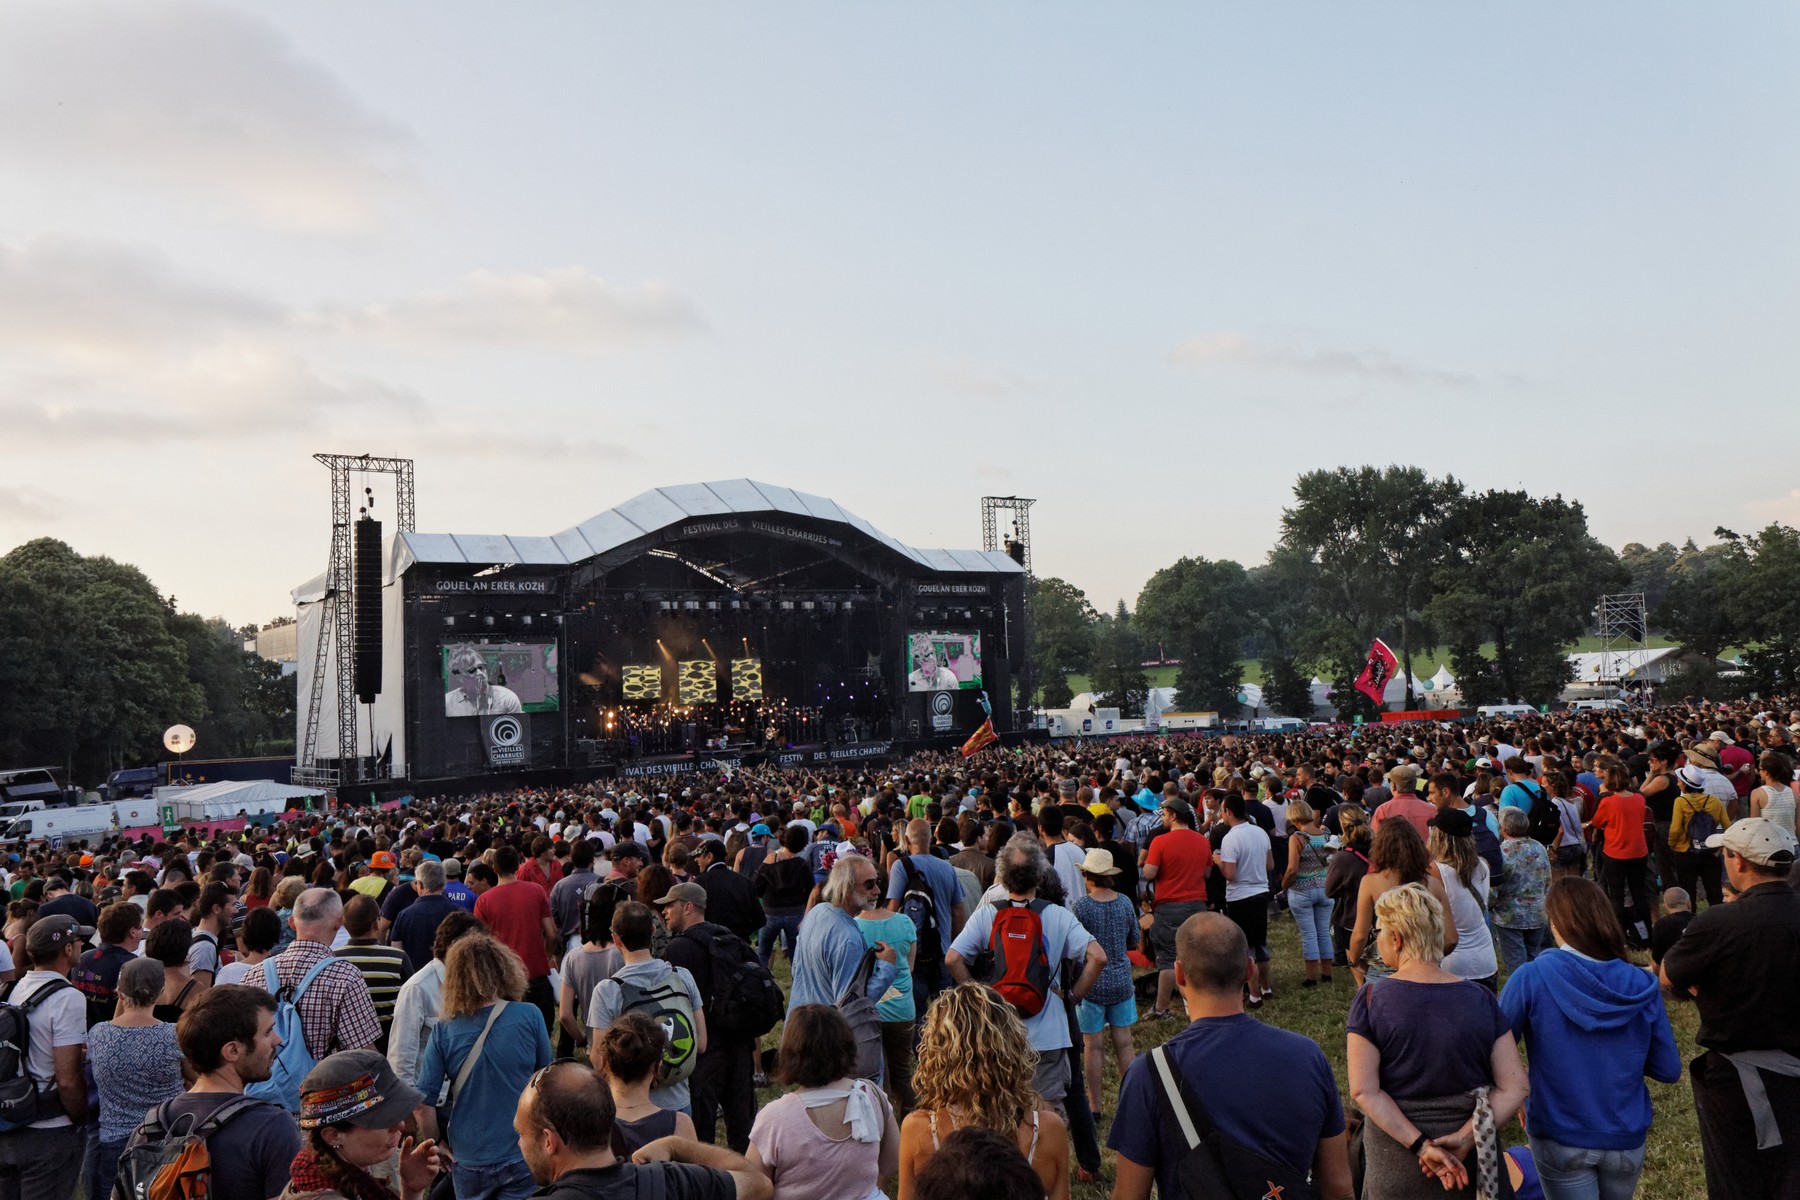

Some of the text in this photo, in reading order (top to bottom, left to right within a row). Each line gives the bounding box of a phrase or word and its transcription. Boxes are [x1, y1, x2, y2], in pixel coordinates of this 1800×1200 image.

[683, 519, 739, 534] FESTIVAL DES
[752, 520, 785, 535] VIEILLES
[787, 528, 828, 544] CHARRUES
[436, 581, 545, 591] GOUEL AN ERER KOZH
[918, 584, 986, 593] GOUEL AN ERER KOZH
[813, 752, 828, 760] DES
[858, 747, 888, 756] CHARRU
[646, 765, 662, 774] DES
